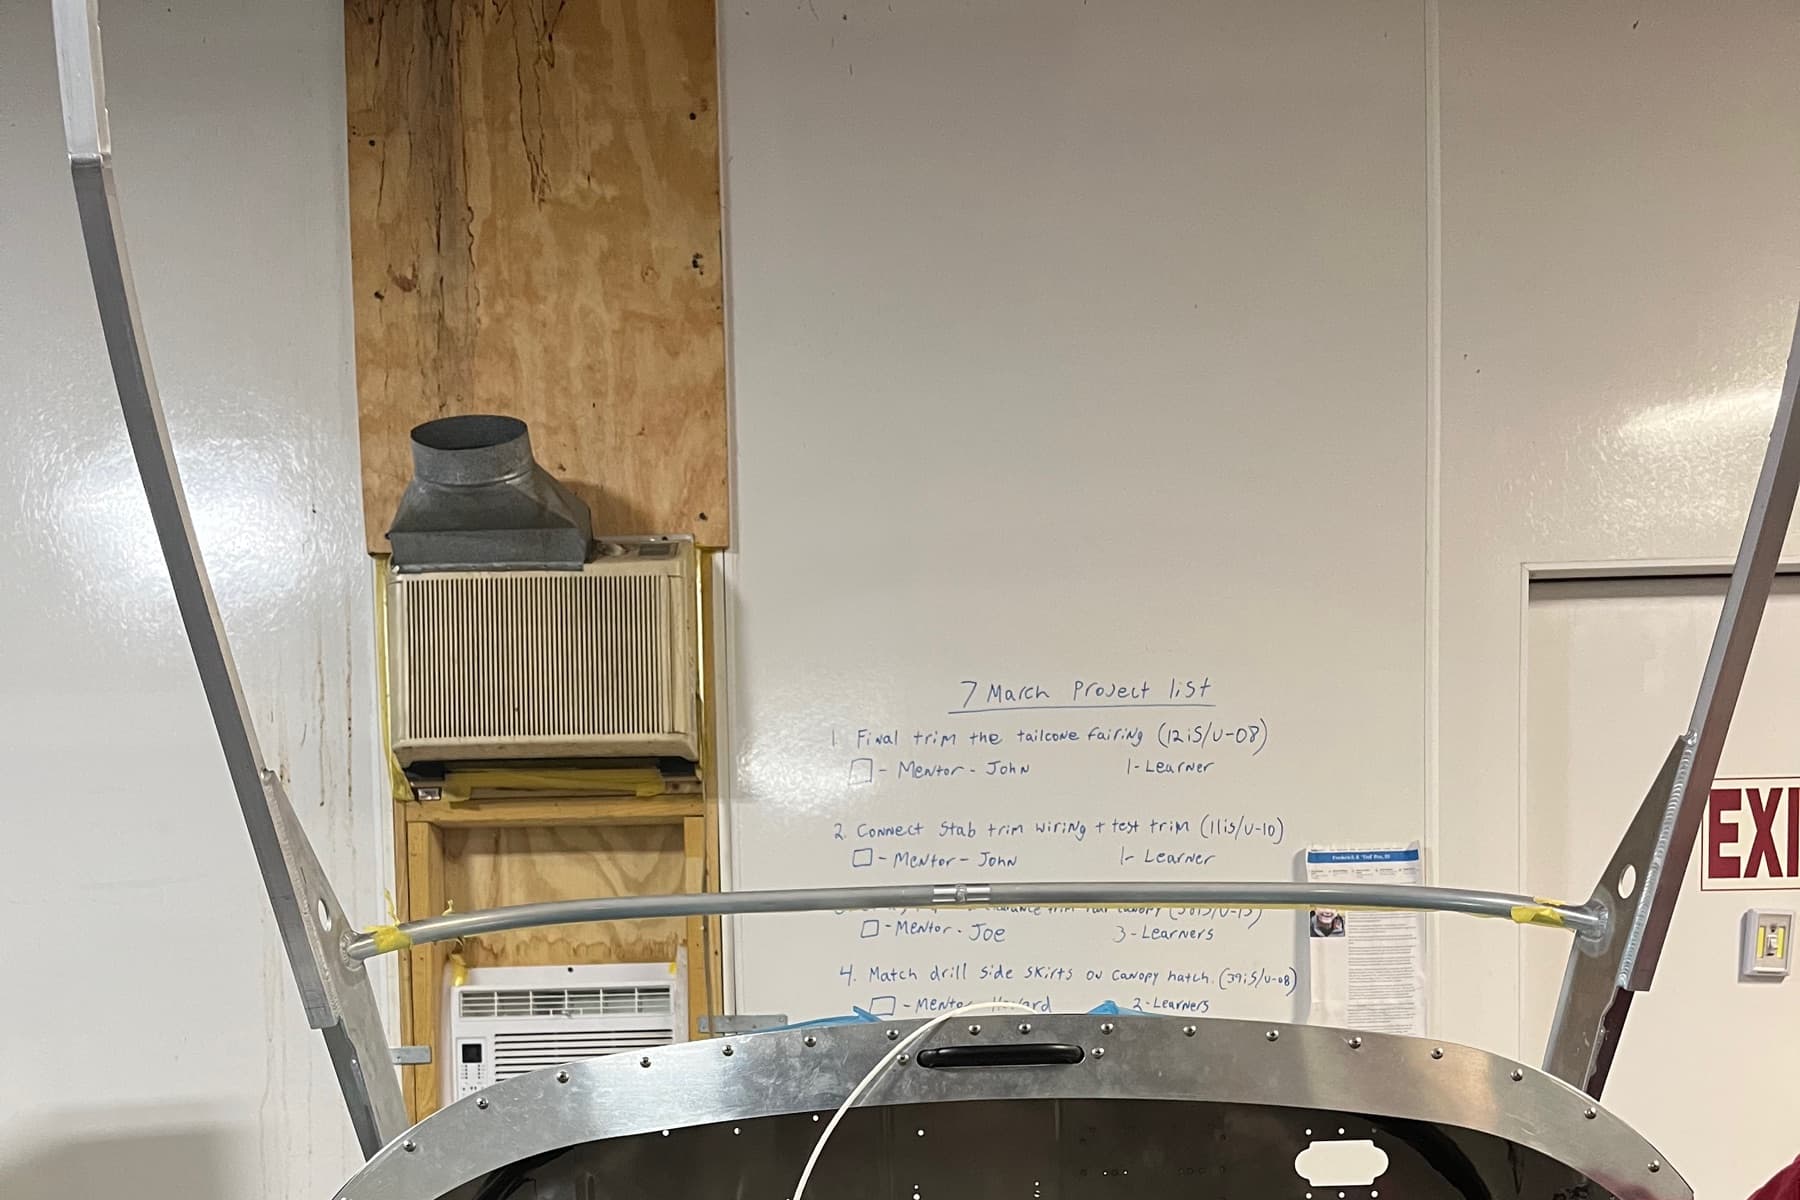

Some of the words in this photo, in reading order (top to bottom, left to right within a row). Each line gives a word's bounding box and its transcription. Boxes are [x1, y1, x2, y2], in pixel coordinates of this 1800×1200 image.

[960, 681, 977, 708] 7
[987, 684, 1049, 702] March
[1074, 680, 1150, 700] Project
[857, 729, 898, 748] Final
[914, 731, 956, 745] trim
[969, 731, 1001, 745] the
[1016, 729, 1080, 743] tailcone
[1087, 727, 1143, 747] fairing
[898, 760, 964, 778] Mentor
[985, 760, 1030, 775] John
[857, 823, 924, 838] Connect
[988, 822, 1023, 837] trim
[1035, 820, 1086, 842] wiring
[1096, 822, 1104, 834] +
[1112, 818, 1139, 834] test
[1150, 820, 1189, 834] trim
[893, 852, 956, 868] Mentor
[978, 851, 1017, 868] John
[896, 920, 952, 936] Mentor
[968, 923, 1006, 942] Joe
[869, 966, 918, 982] Match
[930, 963, 967, 980] drill
[980, 964, 1013, 979] side
[1024, 966, 1074, 981] skirts
[1112, 968, 1159, 986] canopy
